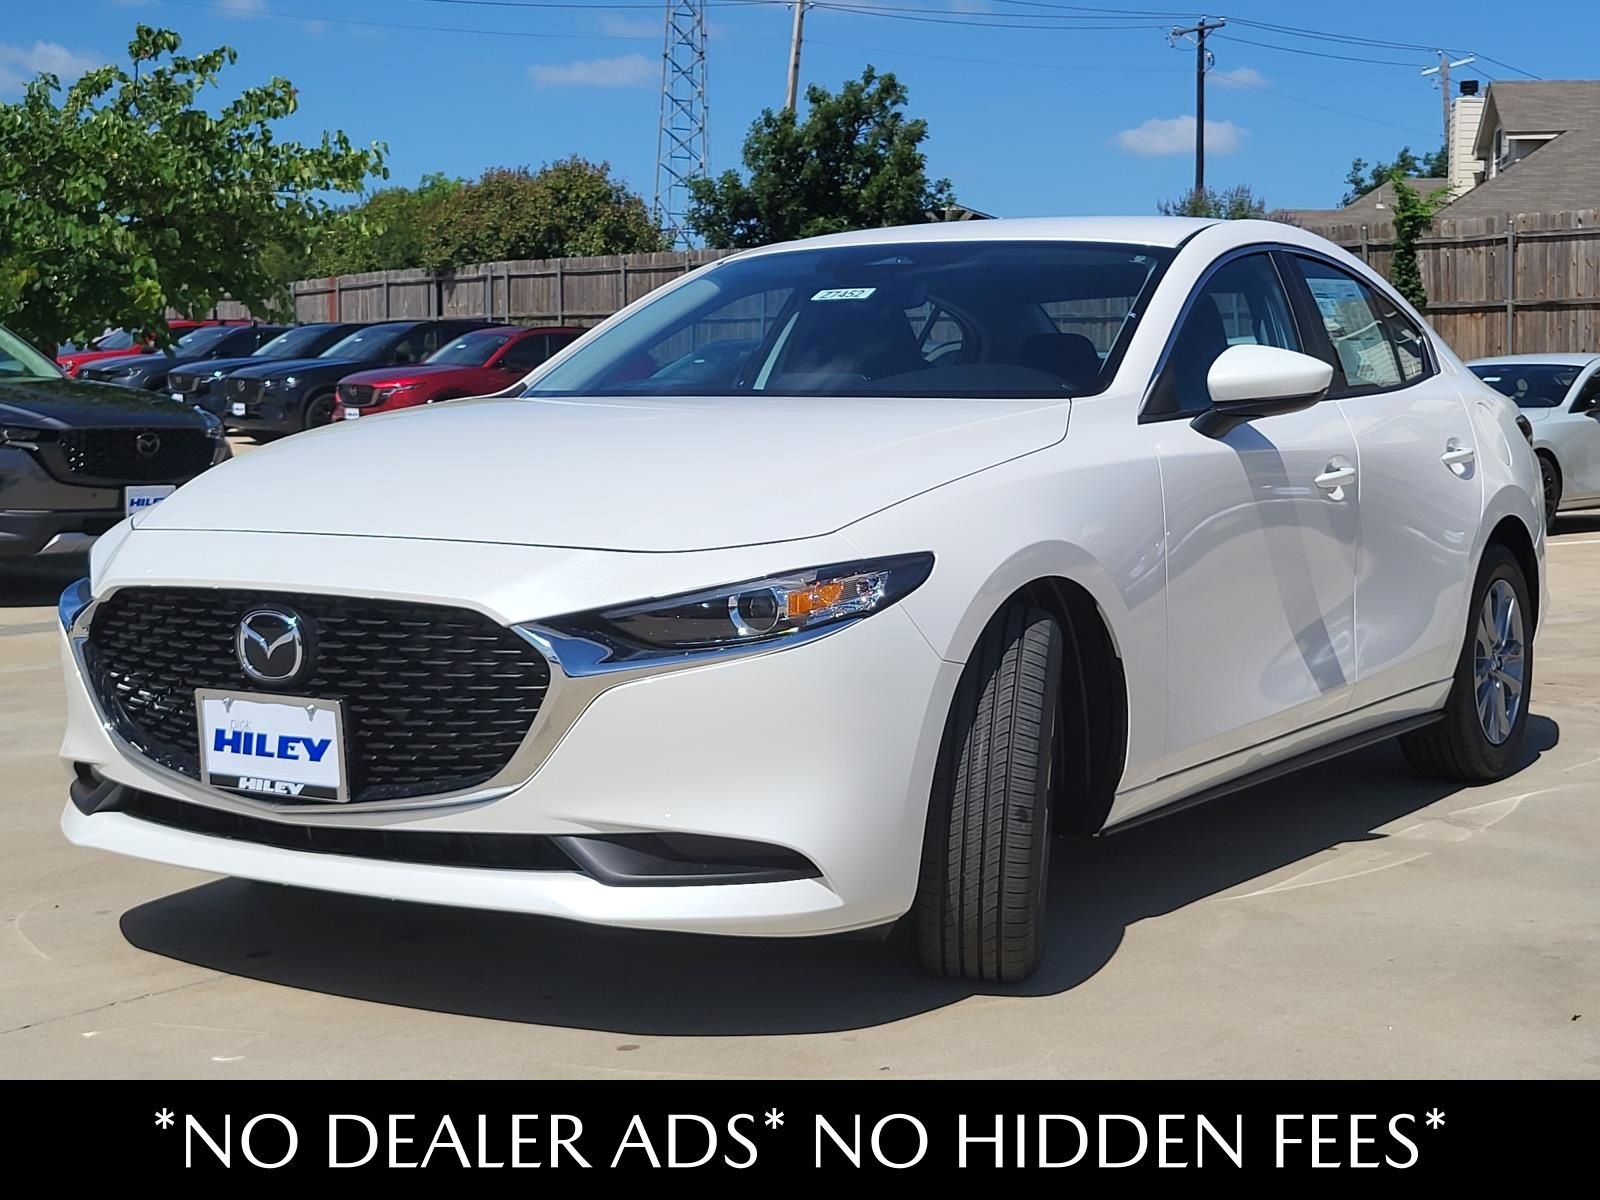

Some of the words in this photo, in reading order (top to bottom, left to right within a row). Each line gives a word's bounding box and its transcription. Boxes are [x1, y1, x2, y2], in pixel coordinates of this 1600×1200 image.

[129, 497, 165, 507] HIL
[214, 728, 332, 762] HILEY
[238, 777, 304, 795] HILEY
